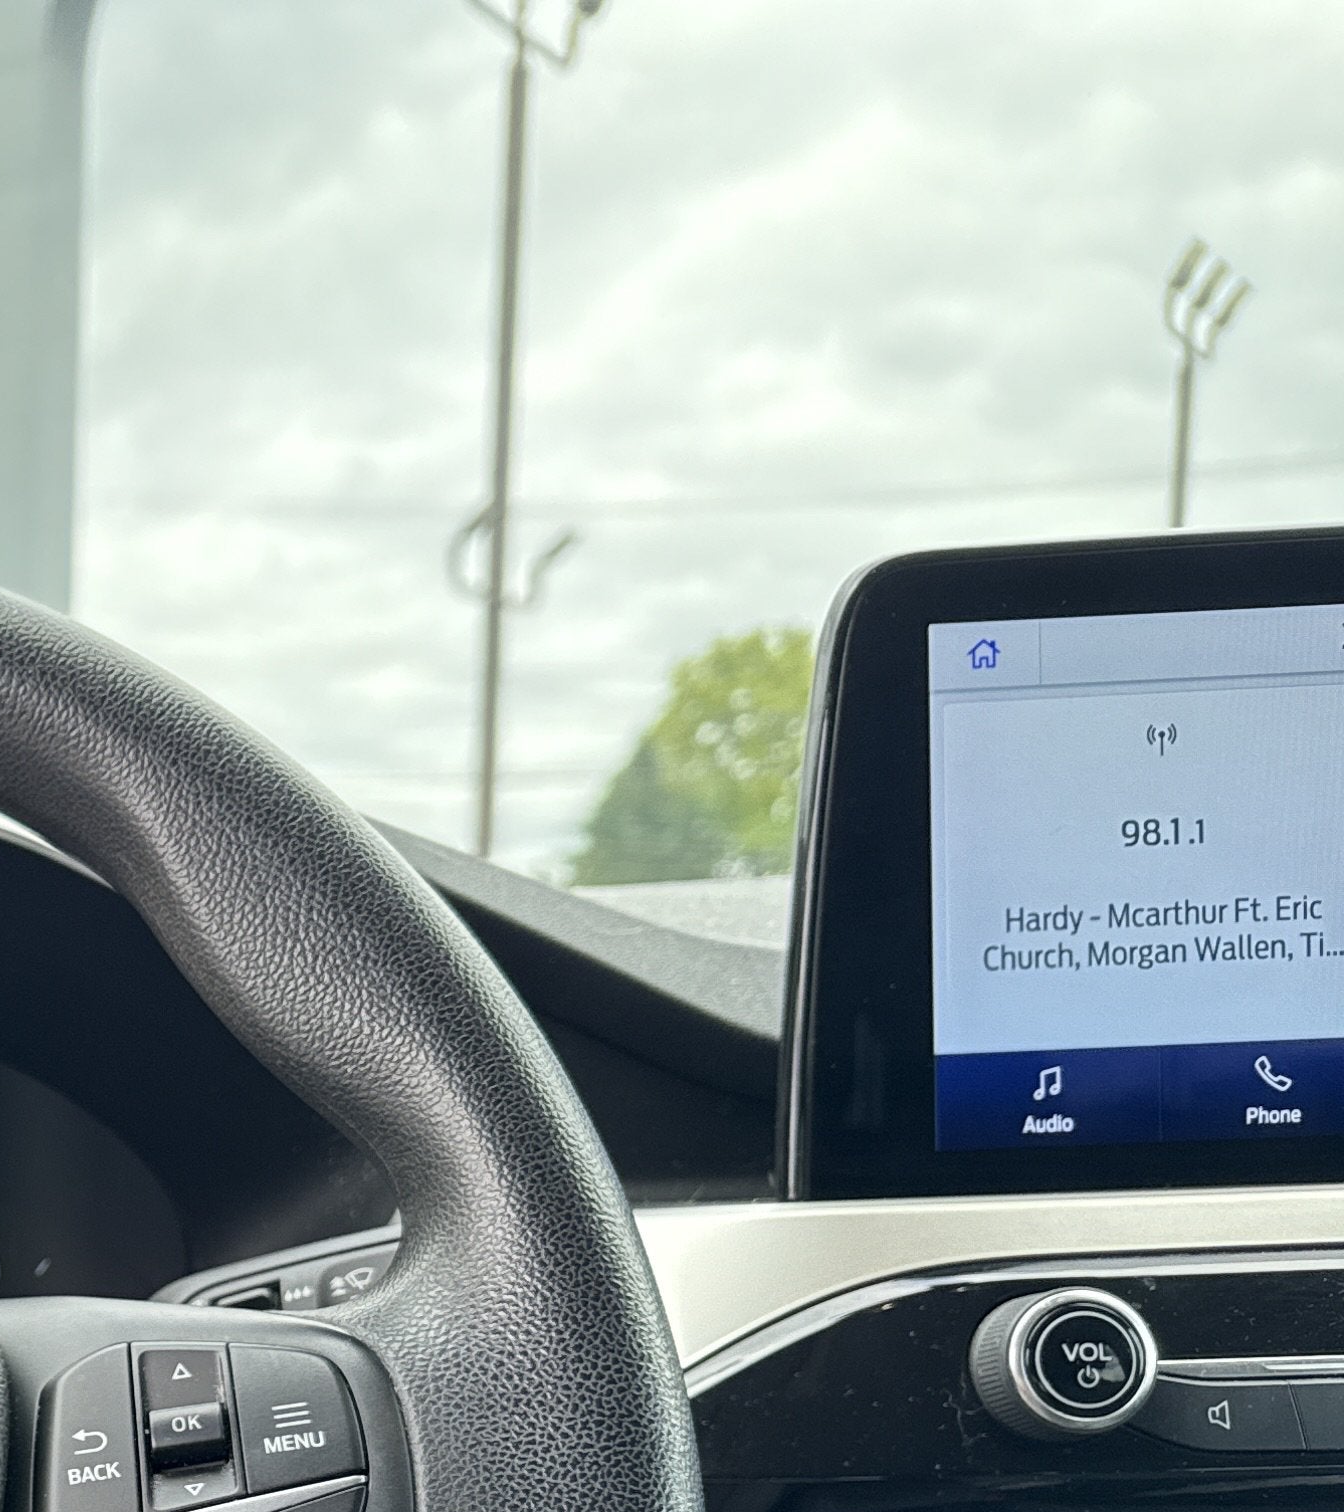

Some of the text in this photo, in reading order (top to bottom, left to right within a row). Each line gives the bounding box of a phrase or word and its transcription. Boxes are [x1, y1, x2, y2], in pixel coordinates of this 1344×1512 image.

[1005, 904, 1084, 935] Hardy
[1108, 899, 1228, 929] Mcarthur
[1234, 897, 1268, 923] Ft.
[1276, 895, 1322, 921] Eric
[983, 942, 1080, 971] Church,
[1087, 939, 1187, 970] Morgan
[1194, 933, 1294, 962] Wallen,
[1022, 1104, 1302, 1134] Audio Phone
[1062, 1342, 1112, 1363] VOL
[170, 1413, 203, 1433] OK
[264, 1430, 325, 1455] MENU
[67, 1462, 121, 1485] BACK
